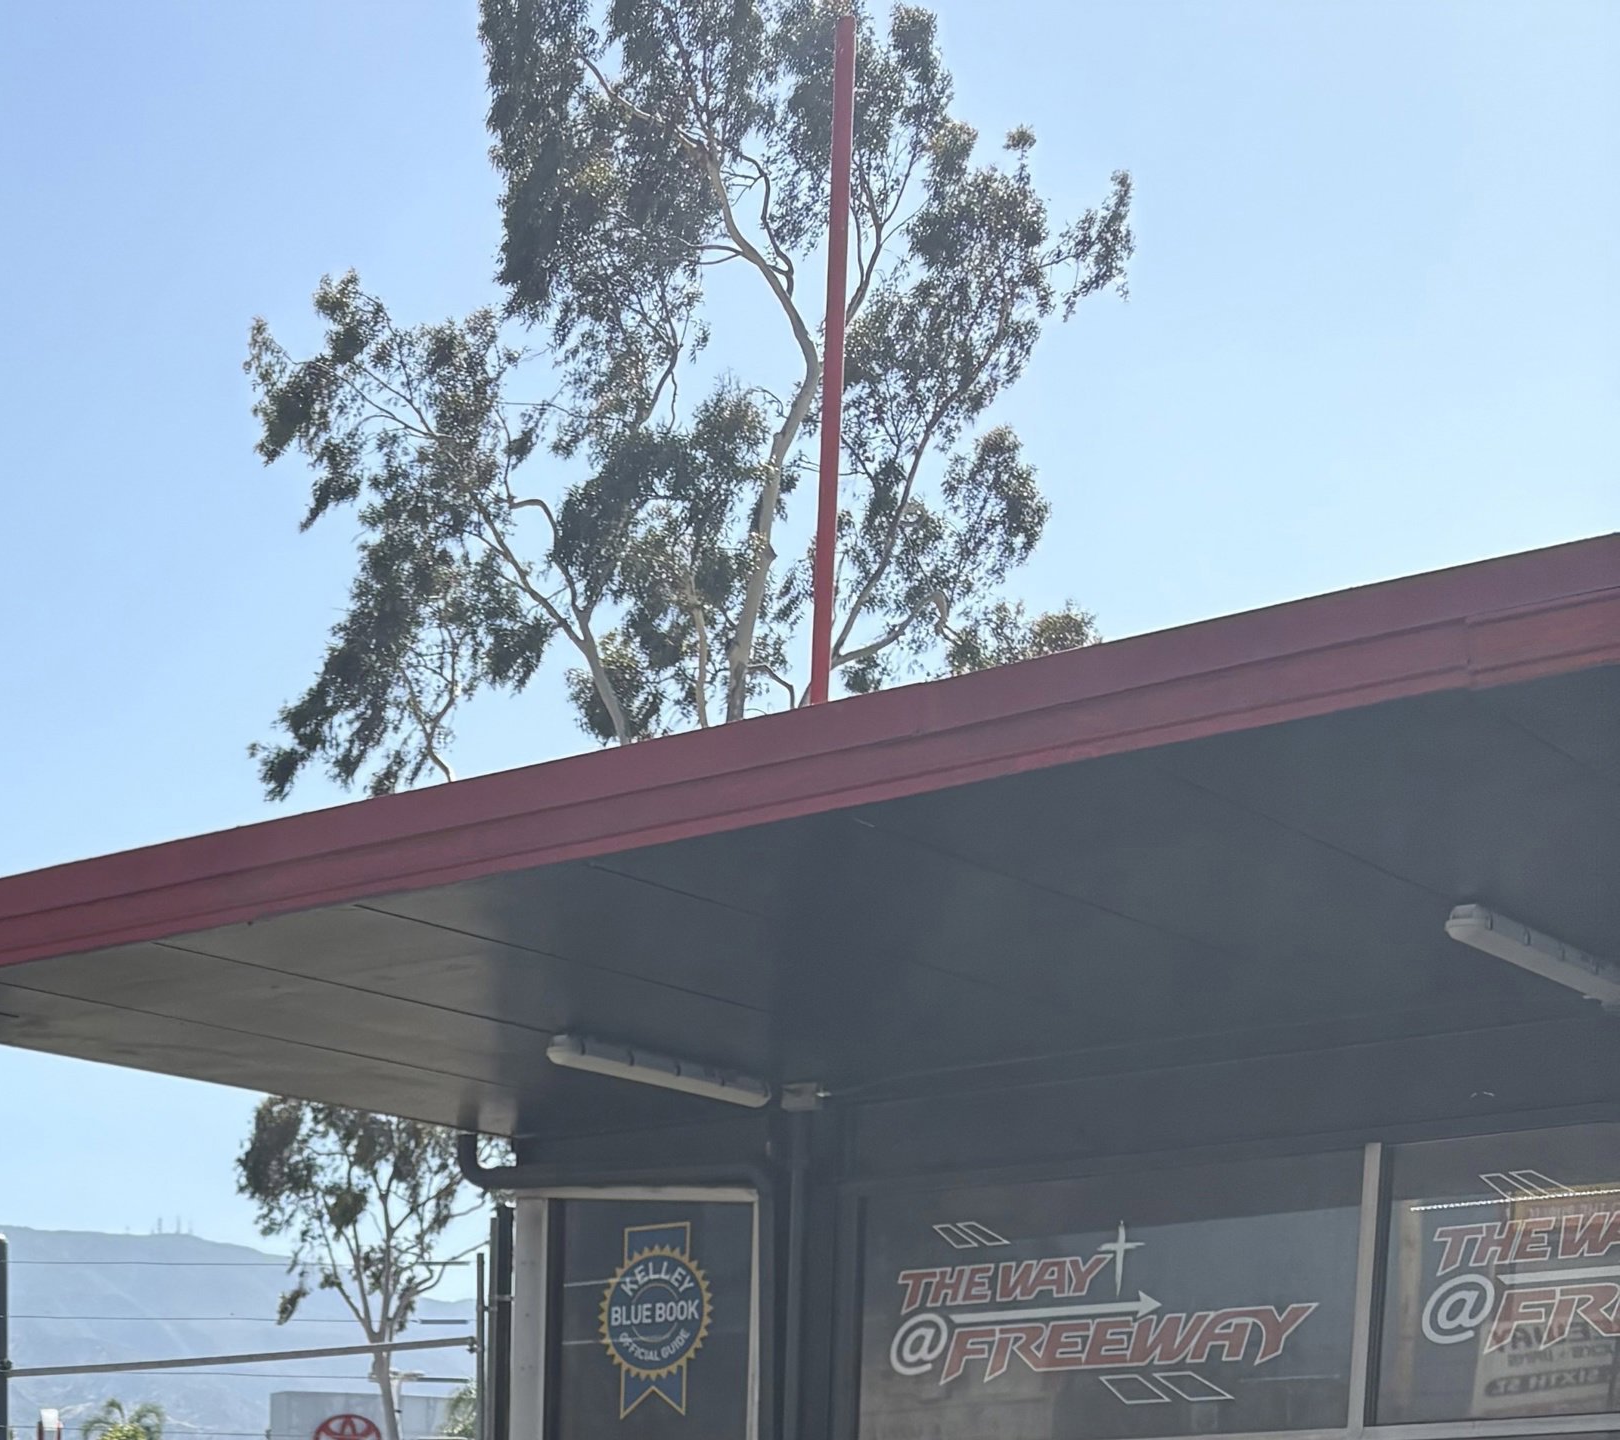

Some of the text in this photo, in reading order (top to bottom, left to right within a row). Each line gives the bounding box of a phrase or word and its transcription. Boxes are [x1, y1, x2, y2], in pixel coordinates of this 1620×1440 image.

[620, 1261, 695, 1297] KELLEY
[611, 1299, 699, 1326] BLUE BOOK
[620, 1327, 691, 1361] OFFICIAL GUIDE
